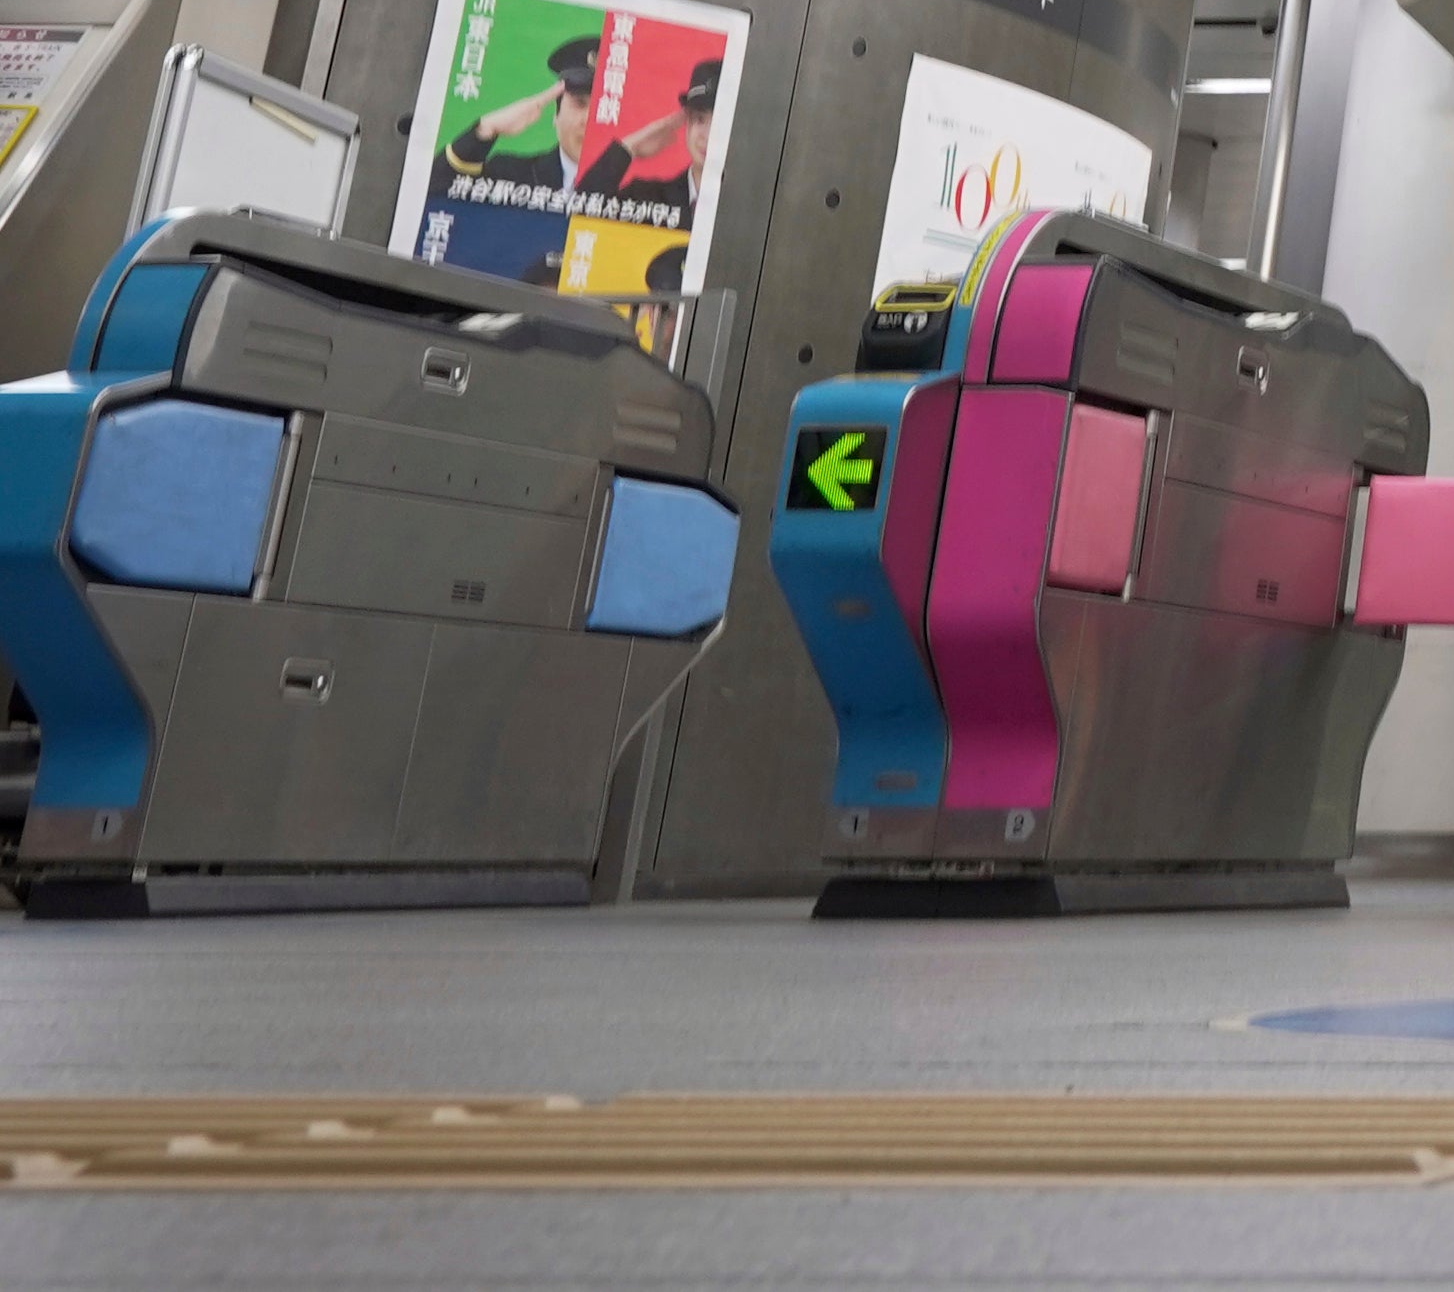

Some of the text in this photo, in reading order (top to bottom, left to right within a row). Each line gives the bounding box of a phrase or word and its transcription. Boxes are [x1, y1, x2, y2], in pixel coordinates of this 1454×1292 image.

[595, 11, 637, 126] 東急電鉄
[447, 173, 682, 229] 渋谷駅の安全は私たちが守る
